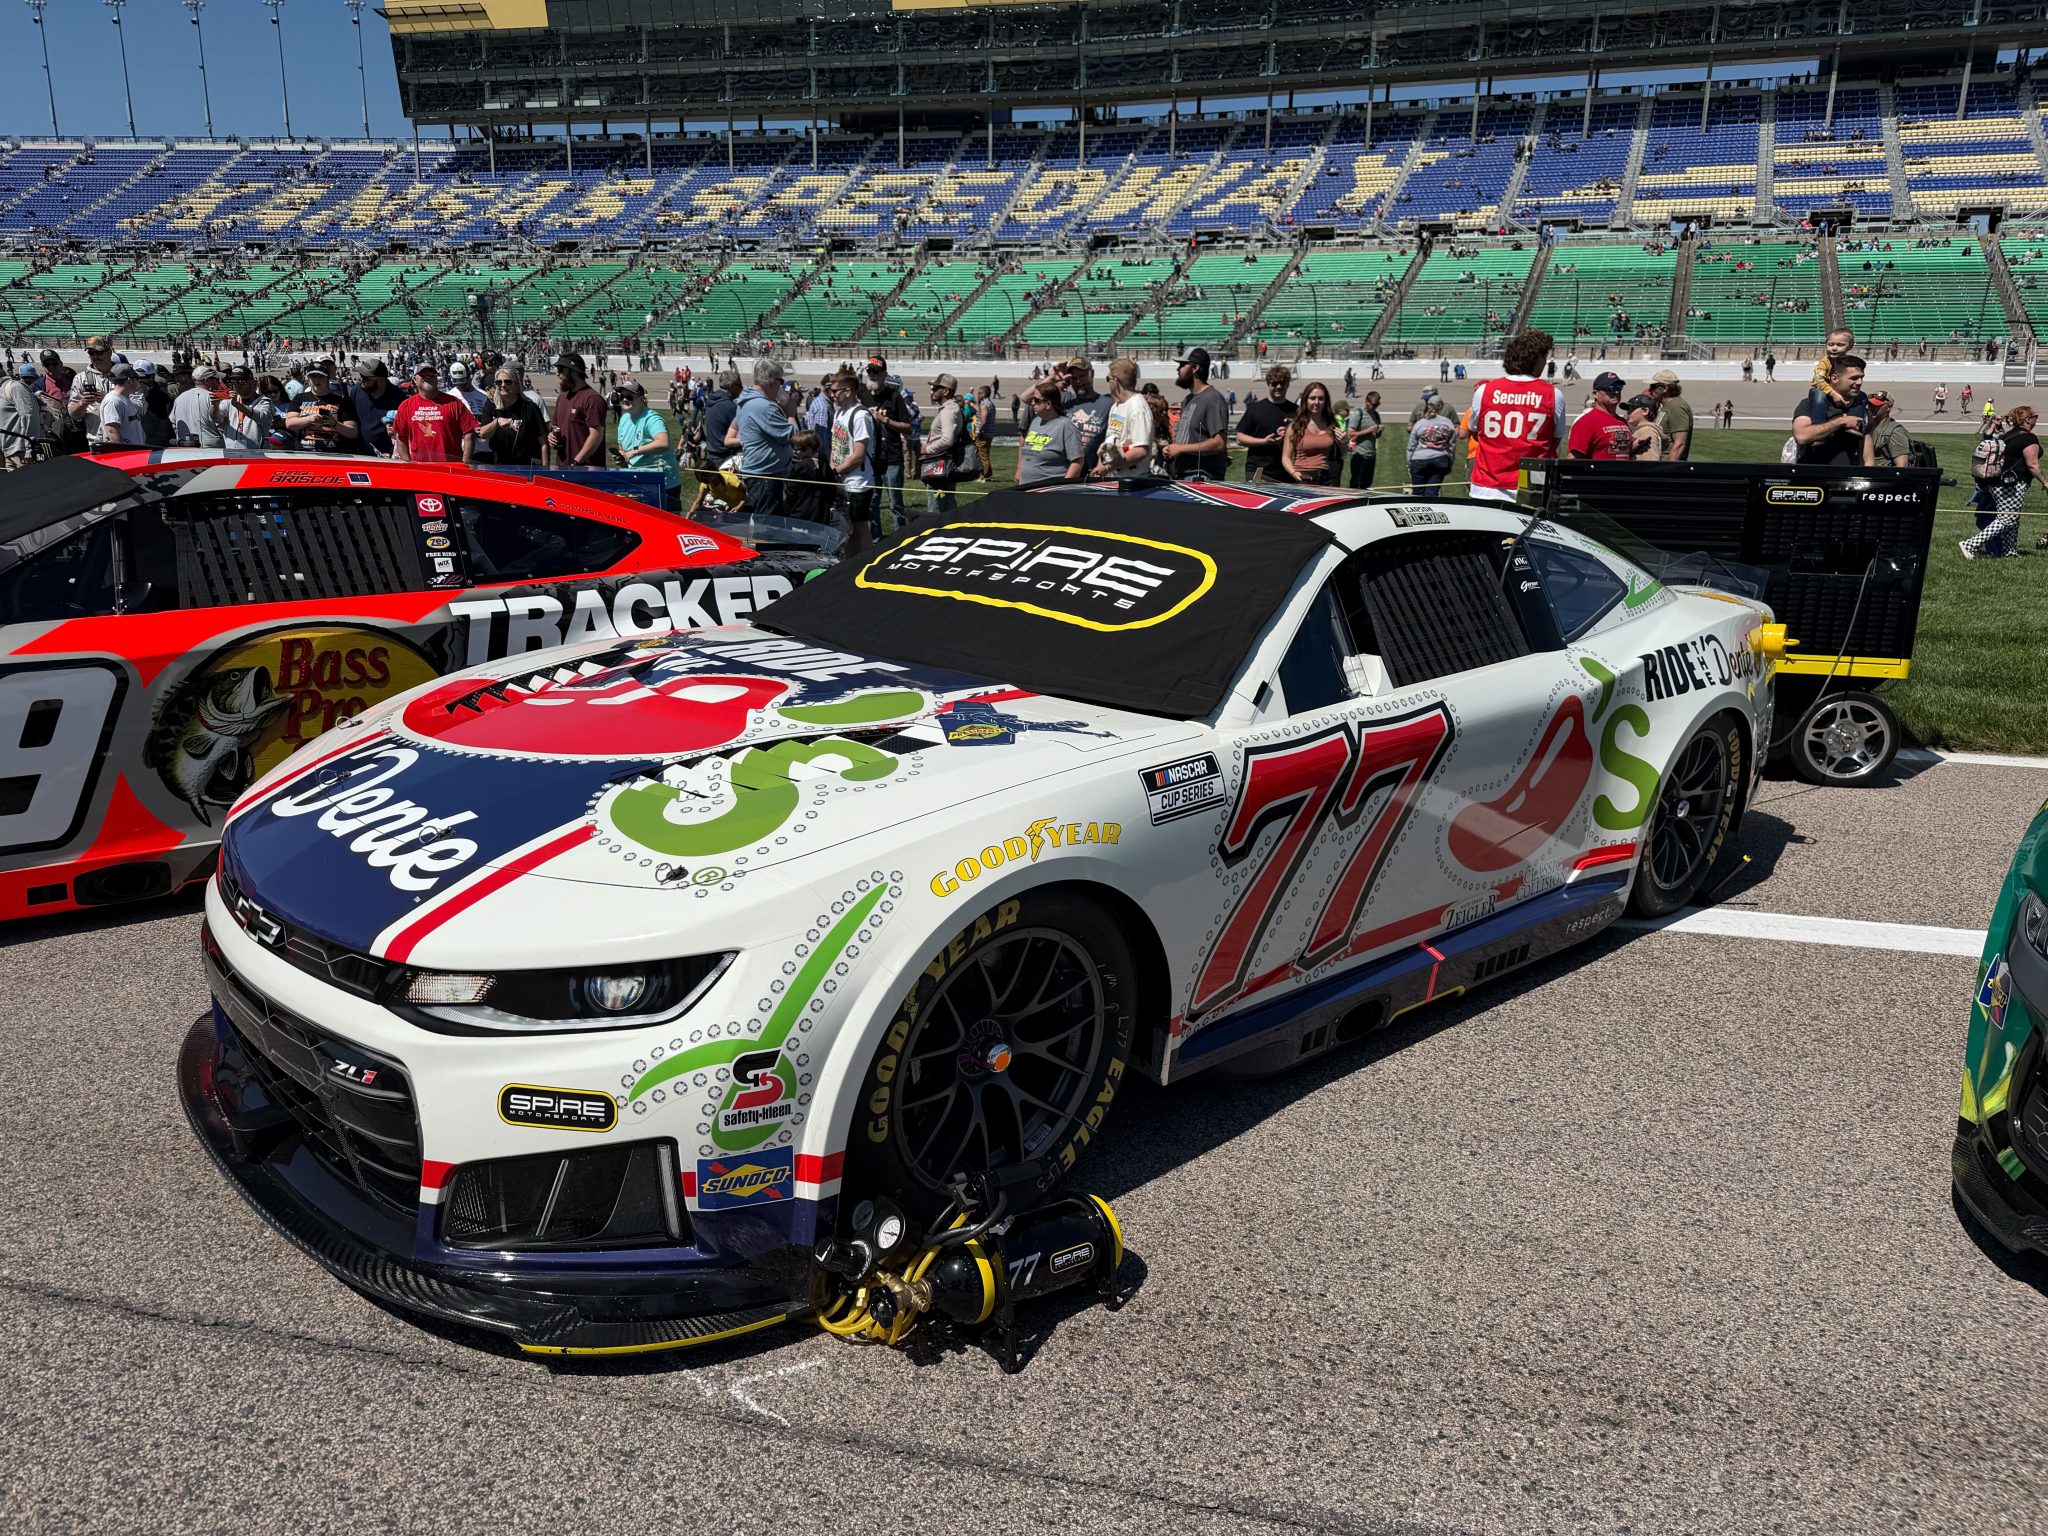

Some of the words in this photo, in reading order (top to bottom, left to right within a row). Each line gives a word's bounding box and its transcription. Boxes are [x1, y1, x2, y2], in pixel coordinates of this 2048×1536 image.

[1493, 389, 1543, 409] Security
[1484, 410, 1547, 440] 607
[268, 474, 347, 485] BRISCOE
[1772, 490, 1819, 498] SPIRE
[1862, 492, 1921, 503] respect.
[680, 535, 714, 548] Lance
[437, 559, 450, 568] WIX
[900, 536, 1176, 599] SPIRE
[886, 562, 1137, 610] MOTORSPORTS
[276, 637, 392, 692] Bass
[698, 640, 911, 683] RIDE
[1638, 642, 1707, 703] RIDE
[1168, 759, 1209, 784] NASCAR
[1161, 791, 1181, 810] CUP
[1181, 781, 1214, 804] SERIES
[1187, 700, 1455, 1023] 77
[1516, 871, 1568, 902] COLLISION
[1446, 892, 1497, 931] ZEIGLER
[330, 1059, 378, 1085] ZL1
[509, 1094, 605, 1117] SPIRE
[509, 1110, 605, 1122] MOTORSPORTS
[1060, 1056, 1125, 1173] EAGLE
[705, 1167, 787, 1192] SUNOCO
[1009, 1251, 1042, 1290] 77
